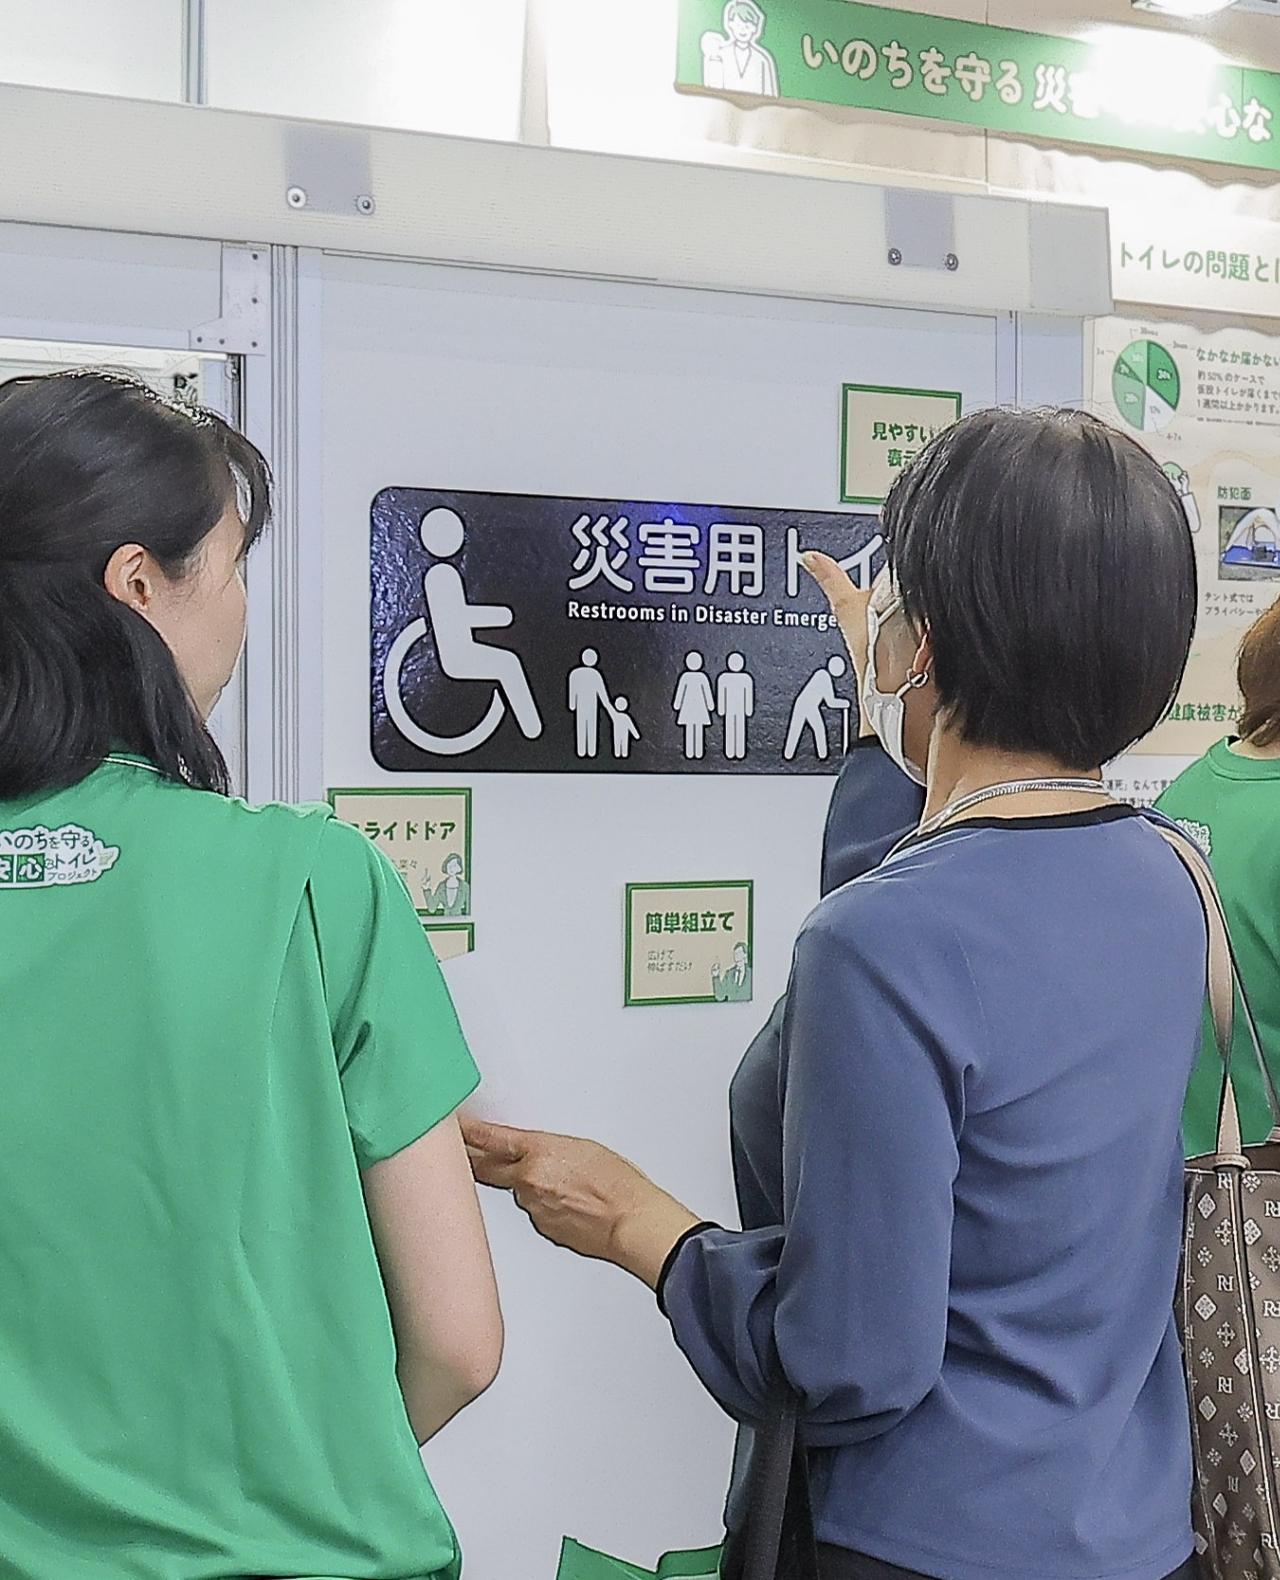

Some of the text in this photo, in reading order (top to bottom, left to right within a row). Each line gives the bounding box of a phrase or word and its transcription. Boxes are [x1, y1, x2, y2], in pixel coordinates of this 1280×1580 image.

[801, 34, 1023, 104] いのちを守る
[1217, 486, 1251, 501] 防犯面
[568, 514, 884, 598] 災害用トイ
[568, 601, 838, 632] Restrooms in Disaster Emerge
[351, 821, 456, 841] ライドドア
[645, 911, 735, 934] 簡単組立て
